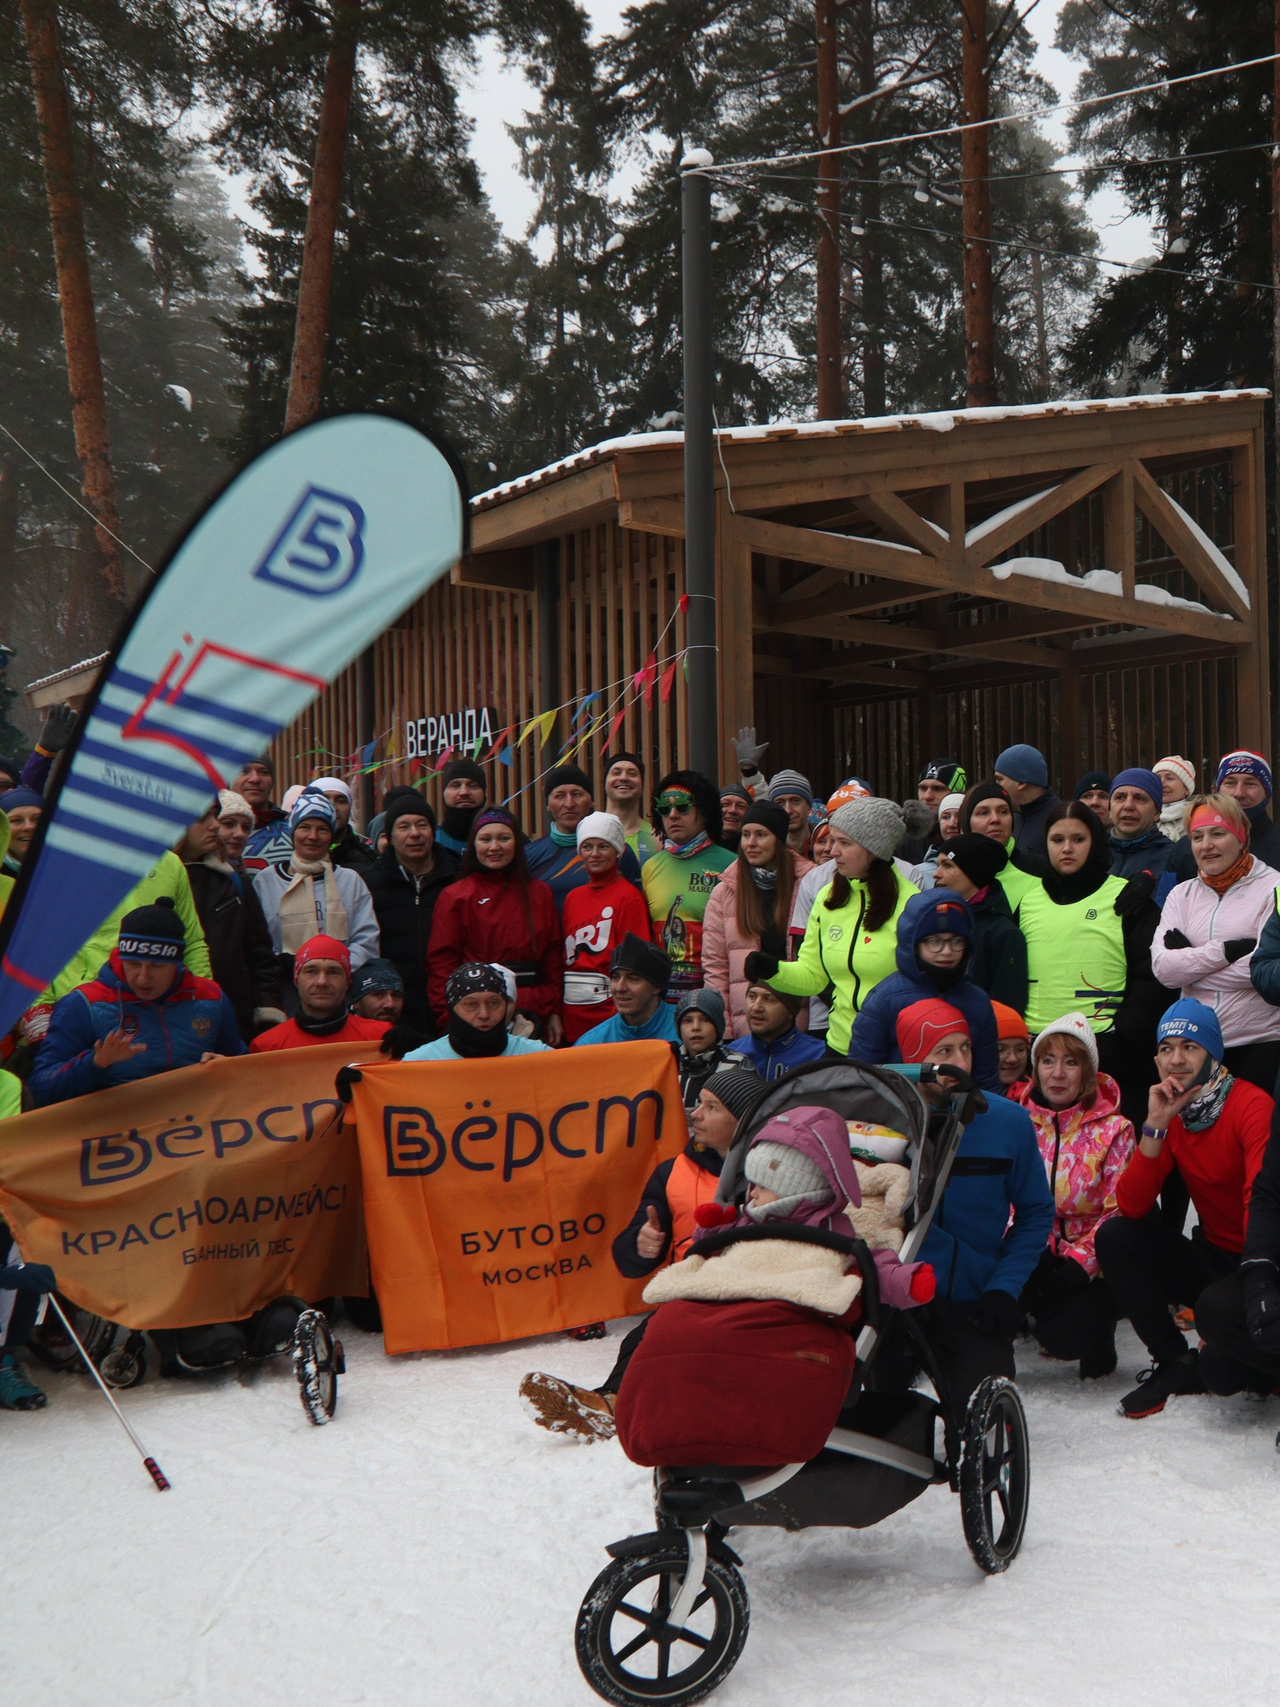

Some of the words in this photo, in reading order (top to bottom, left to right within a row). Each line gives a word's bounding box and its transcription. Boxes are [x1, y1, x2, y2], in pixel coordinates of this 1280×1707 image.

[406, 706, 493, 758] ВЕРАНДА
[119, 938, 178, 957] RUSSIA
[1160, 1020, 1187, 1032] ТЕМП
[1187, 1023, 1199, 1032] 10
[62, 1183, 347, 1256] КРАСНОАРМЕЙС
[461, 1213, 606, 1255] БУТОВО
[182, 1238, 260, 1265] БАННЫЙ
[482, 1253, 593, 1287] МОСКВА
